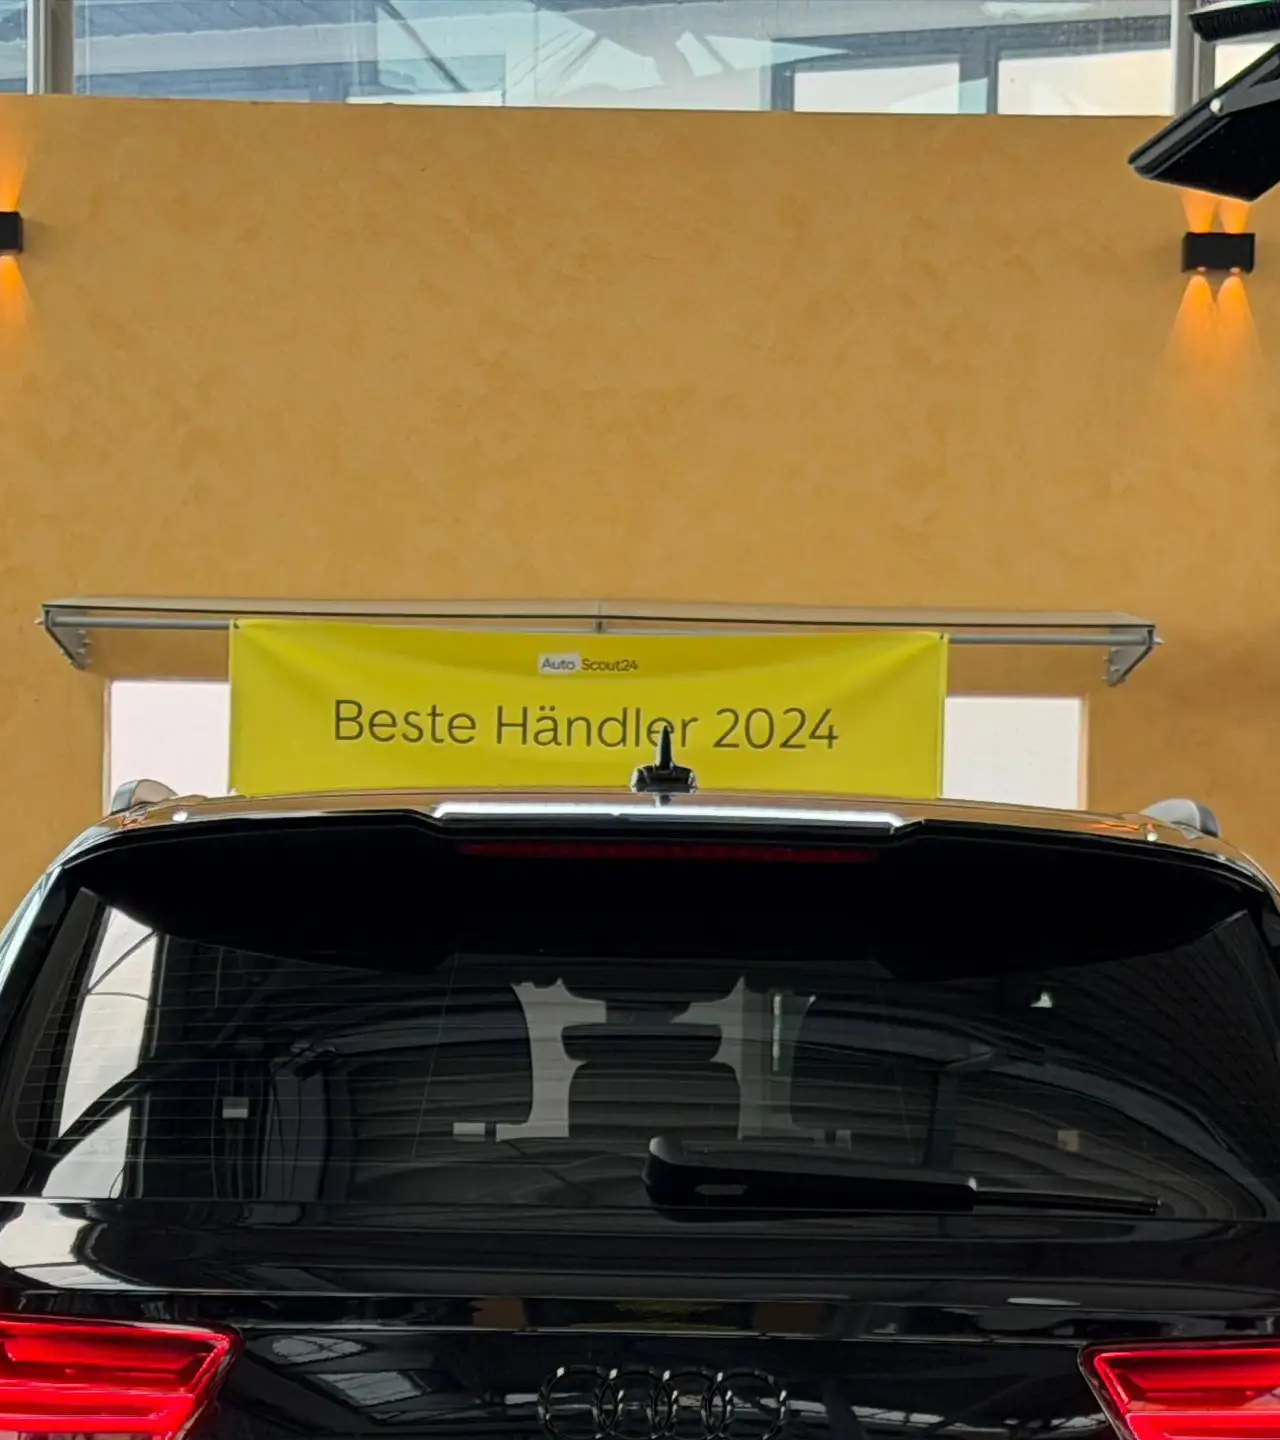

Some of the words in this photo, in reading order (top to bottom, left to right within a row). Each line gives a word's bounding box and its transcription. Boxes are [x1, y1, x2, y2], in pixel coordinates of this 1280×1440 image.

[541, 656, 576, 671] Auto
[581, 658, 639, 673] Scout24
[334, 699, 476, 743] Beste
[496, 705, 699, 749] Händler
[714, 707, 839, 750] 2024
